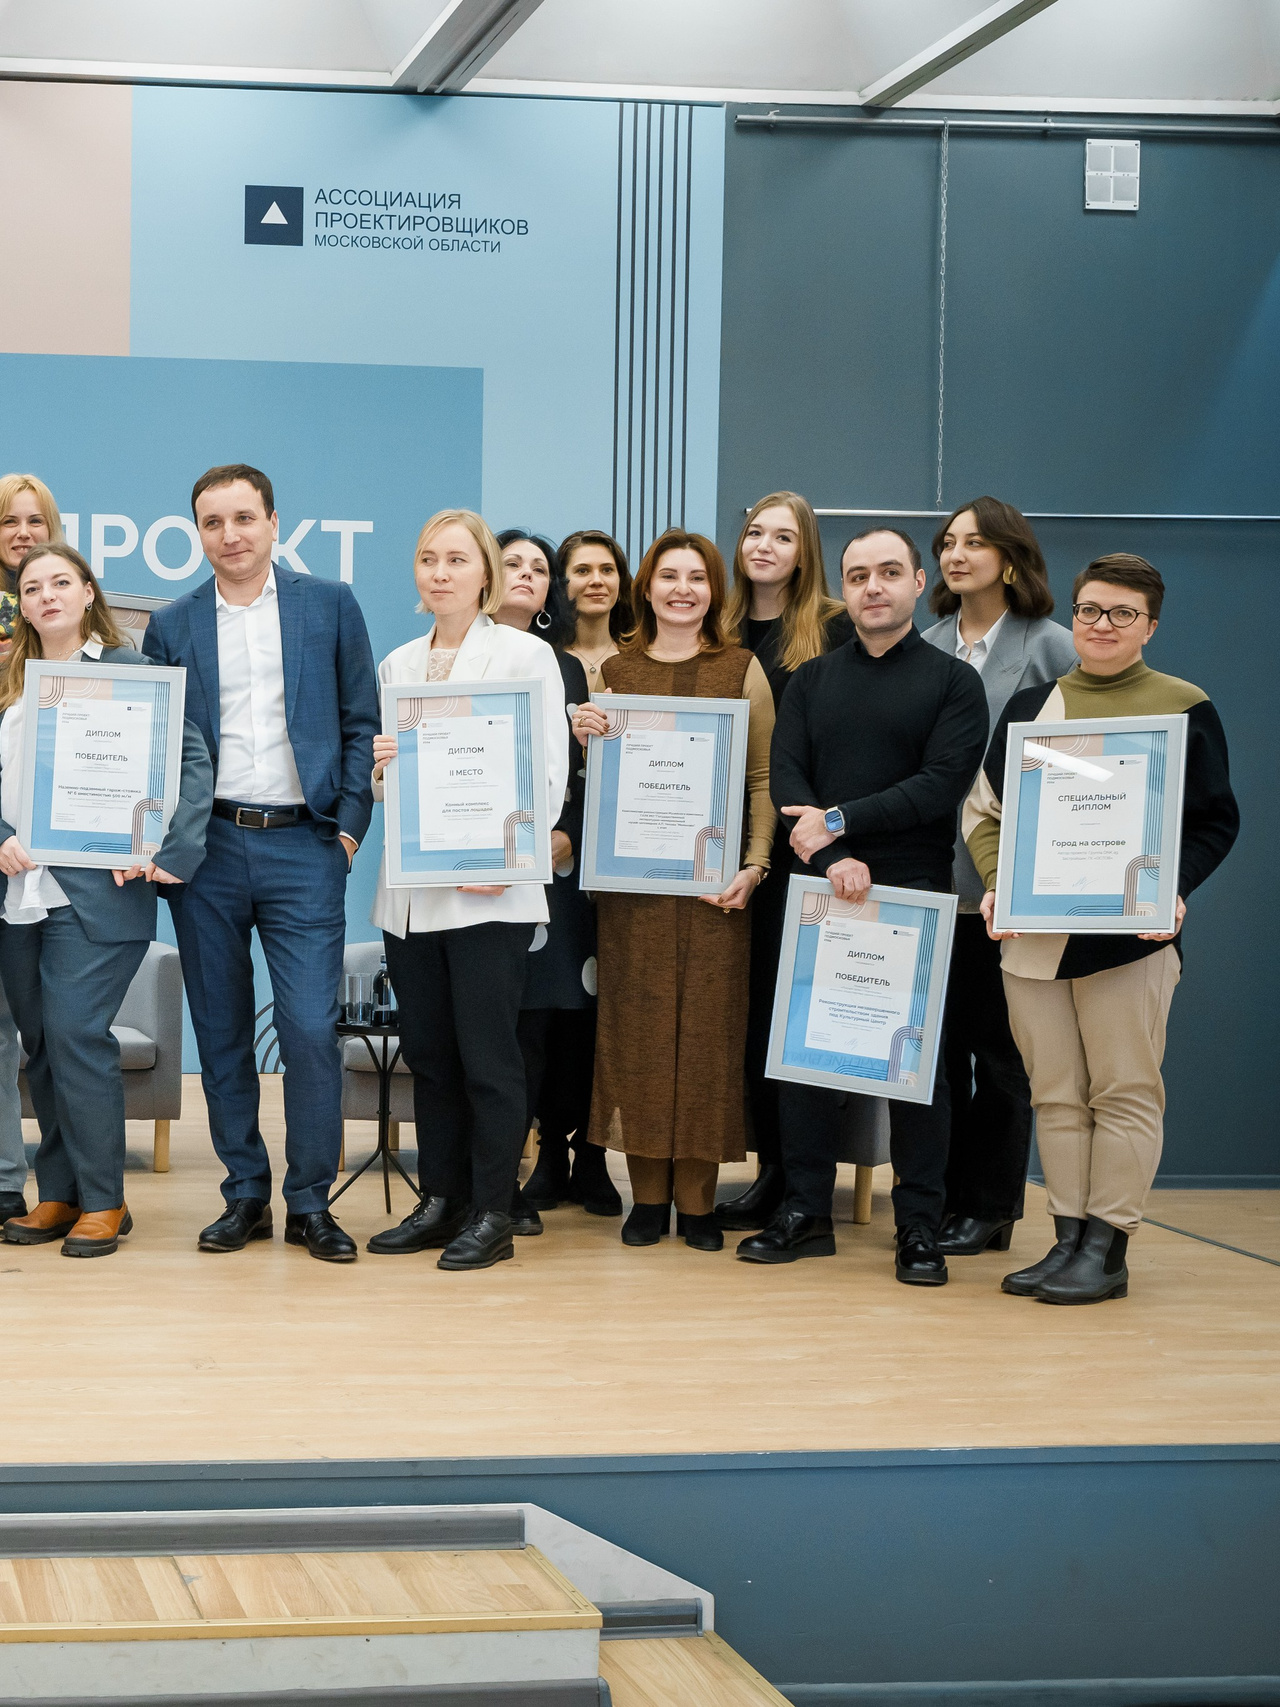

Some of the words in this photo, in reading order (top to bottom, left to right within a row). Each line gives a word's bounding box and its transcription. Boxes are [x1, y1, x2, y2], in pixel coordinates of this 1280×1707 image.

[315, 188, 461, 212] АССОЦИАЦИЯ
[315, 212, 529, 237] ПРОЕКТИРОВЩИКОВ
[314, 234, 423, 250] МОСКОВСКОЙ
[428, 239, 501, 253] ОБЛАСТИ
[85, 730, 121, 738] ДИПЛОМ
[448, 747, 484, 755] ДИПЛОМ
[75, 753, 128, 762] ПОБЕДИТЕЛЬ
[649, 760, 684, 768] ДИПЛОМ
[639, 782, 691, 791] ПОБЕДИТЕЛЬ
[1058, 792, 1126, 802] СПЕЦИАЛЬНЫЙ
[847, 950, 885, 961] ДИПЛОМ
[835, 973, 890, 986] ПОБЕДИТЕЛЬ
